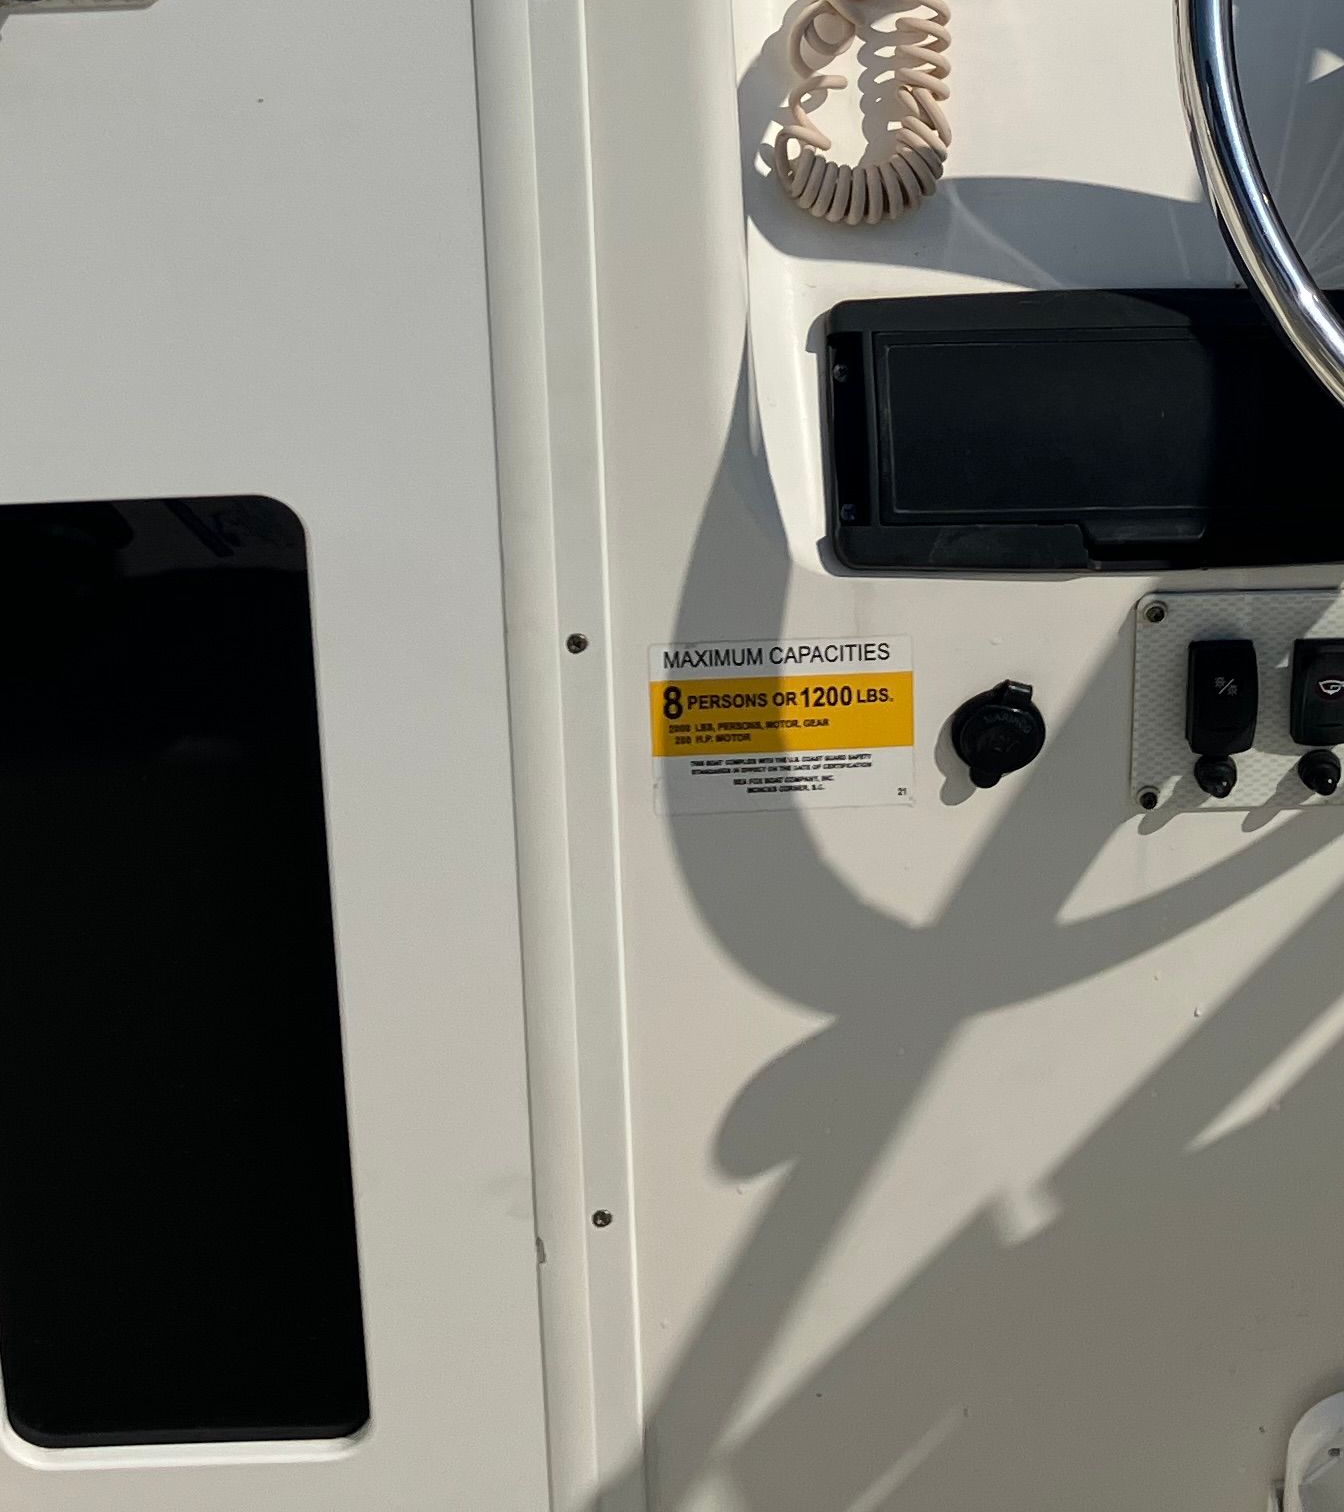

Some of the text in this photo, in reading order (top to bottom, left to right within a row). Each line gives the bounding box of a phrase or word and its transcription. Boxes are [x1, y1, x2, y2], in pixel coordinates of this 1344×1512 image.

[663, 642, 891, 669] MAXIMUM CAPACITIES
[663, 685, 894, 720] 8 PERSONS OR 1200 LBS.
[803, 718, 830, 728] GEAR
[715, 733, 752, 743] MOTOR
